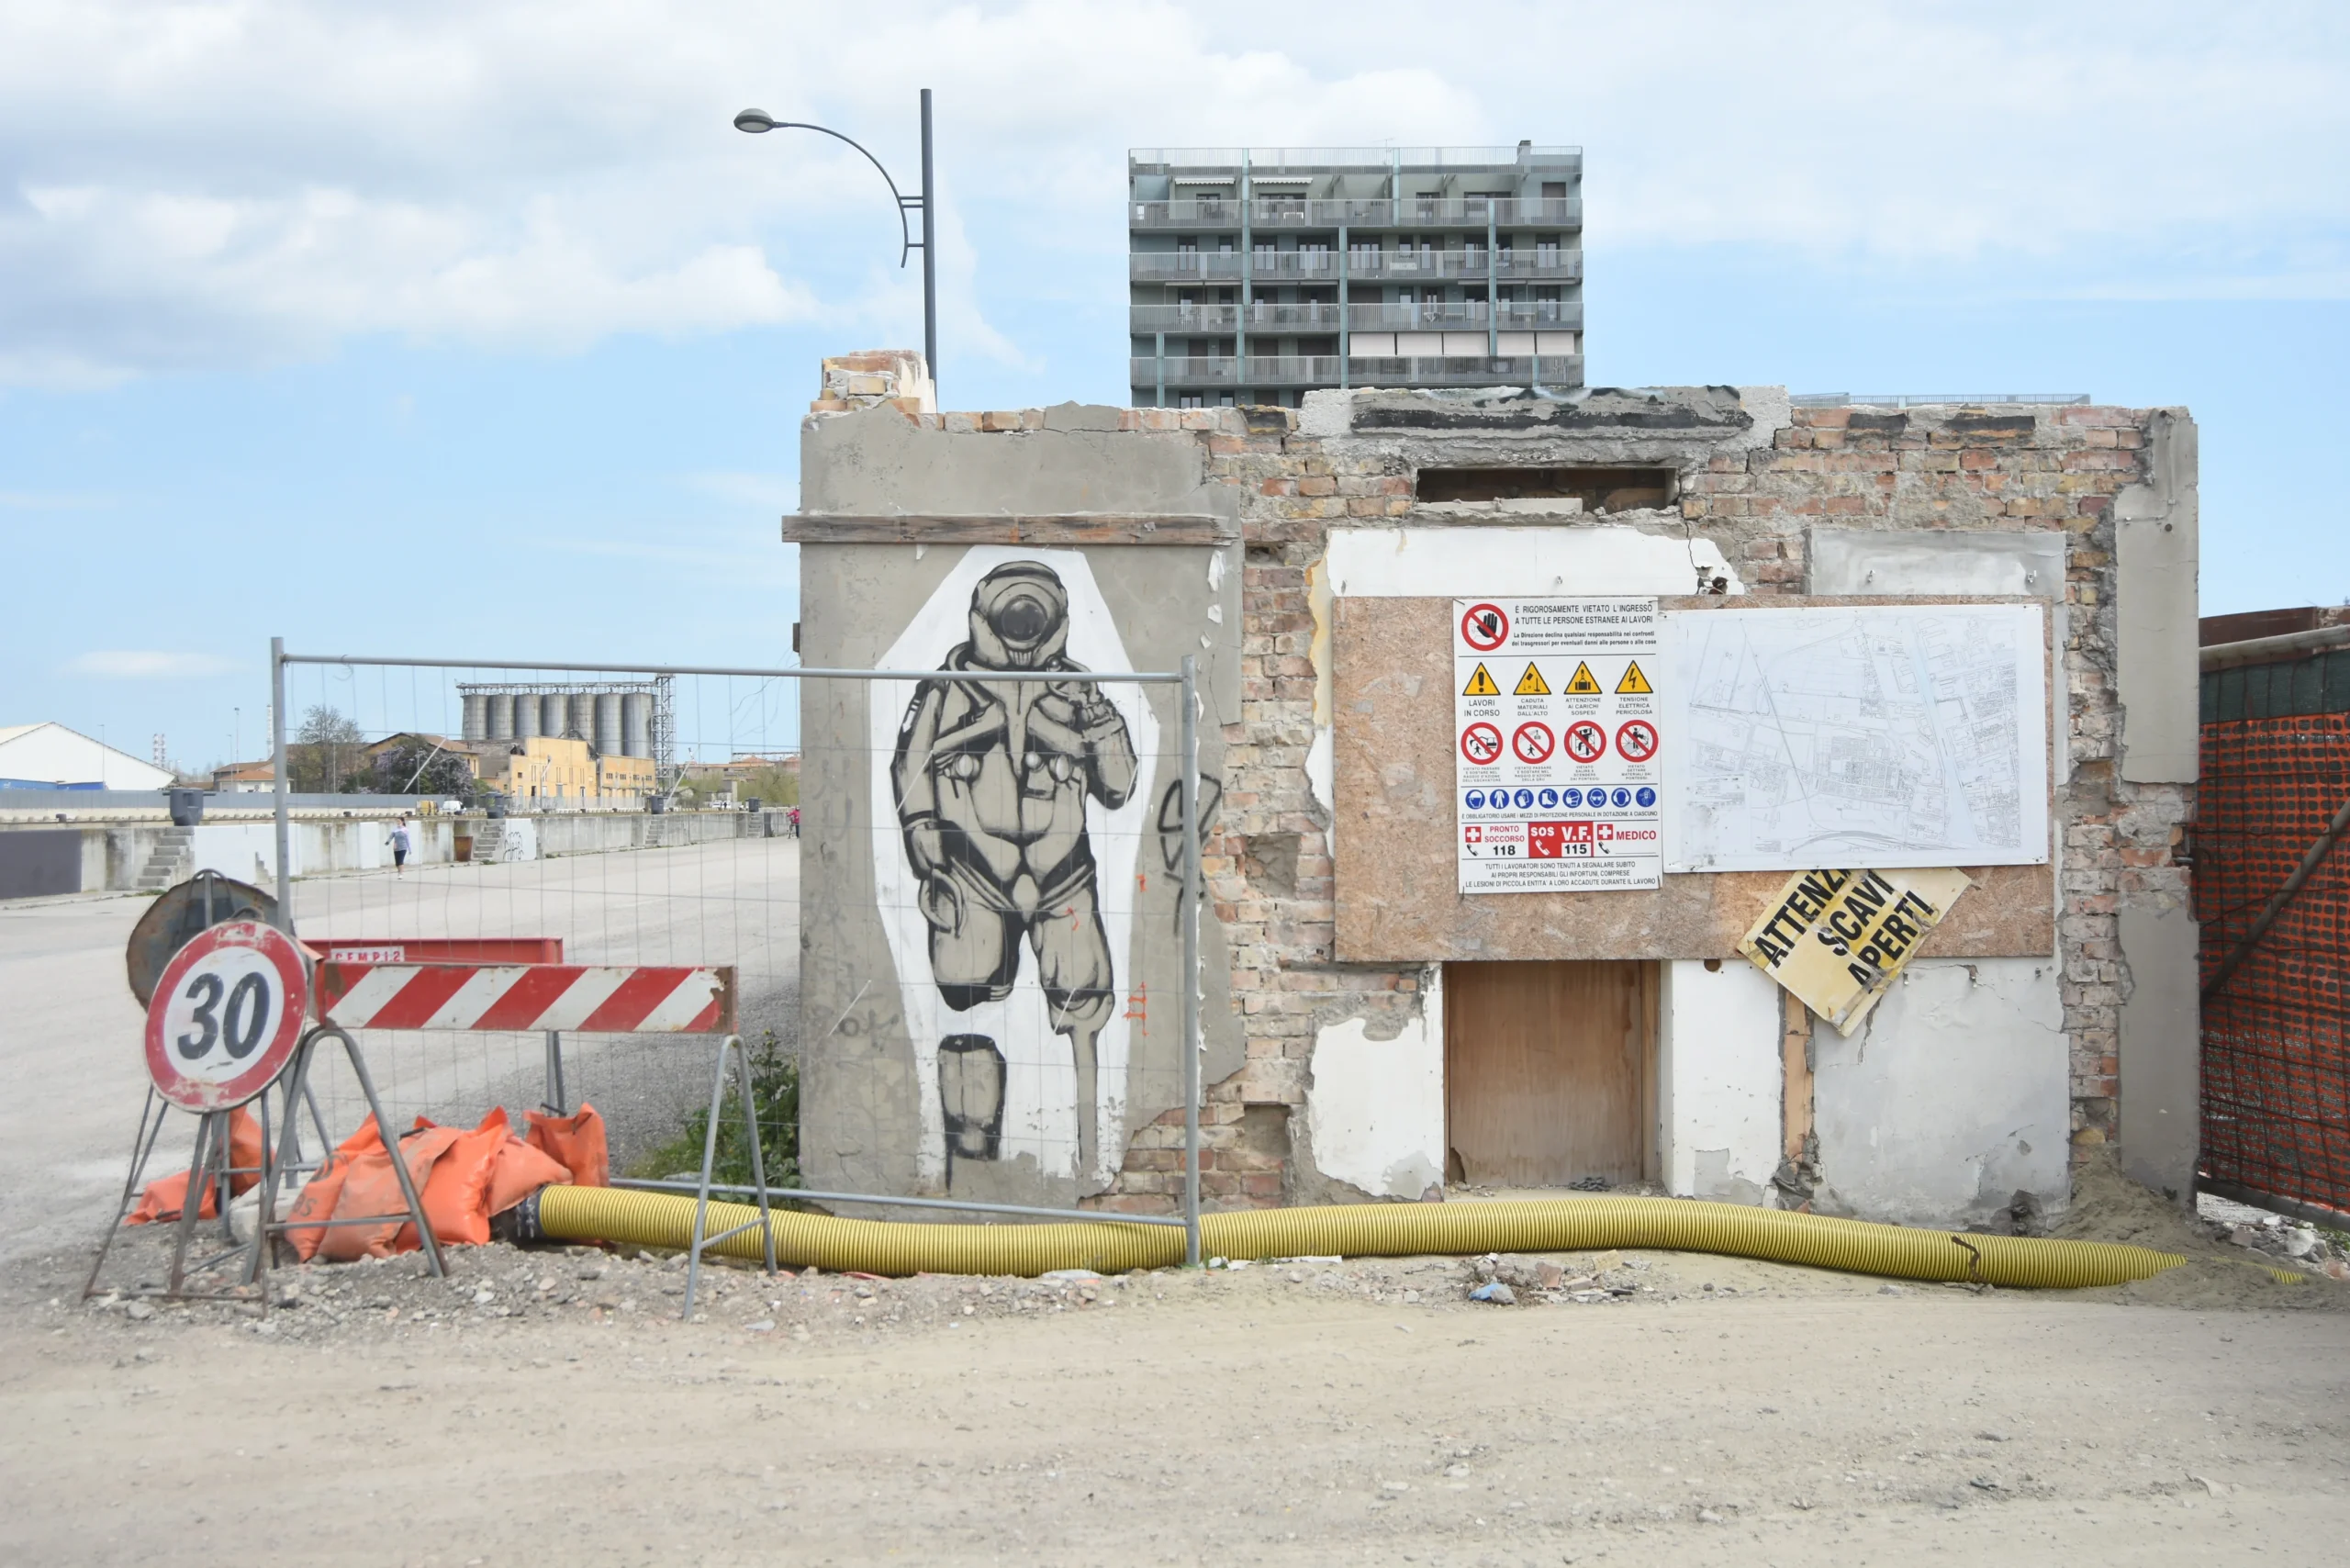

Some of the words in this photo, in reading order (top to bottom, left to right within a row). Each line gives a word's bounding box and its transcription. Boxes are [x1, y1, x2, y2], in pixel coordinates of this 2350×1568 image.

[1523, 605, 1579, 613] RIGOROSAMENTE
[1582, 604, 1610, 613] VIETATO
[1530, 827, 1555, 837] SOS
[1561, 826, 1591, 841] V.F.
[1616, 830, 1656, 841] MEDICO
[1493, 845, 1515, 856] 118
[1564, 844, 1587, 854] 115
[1817, 869, 1895, 956] SCAVI
[1847, 890, 1935, 994] APERTI
[177, 972, 270, 1060] 30
